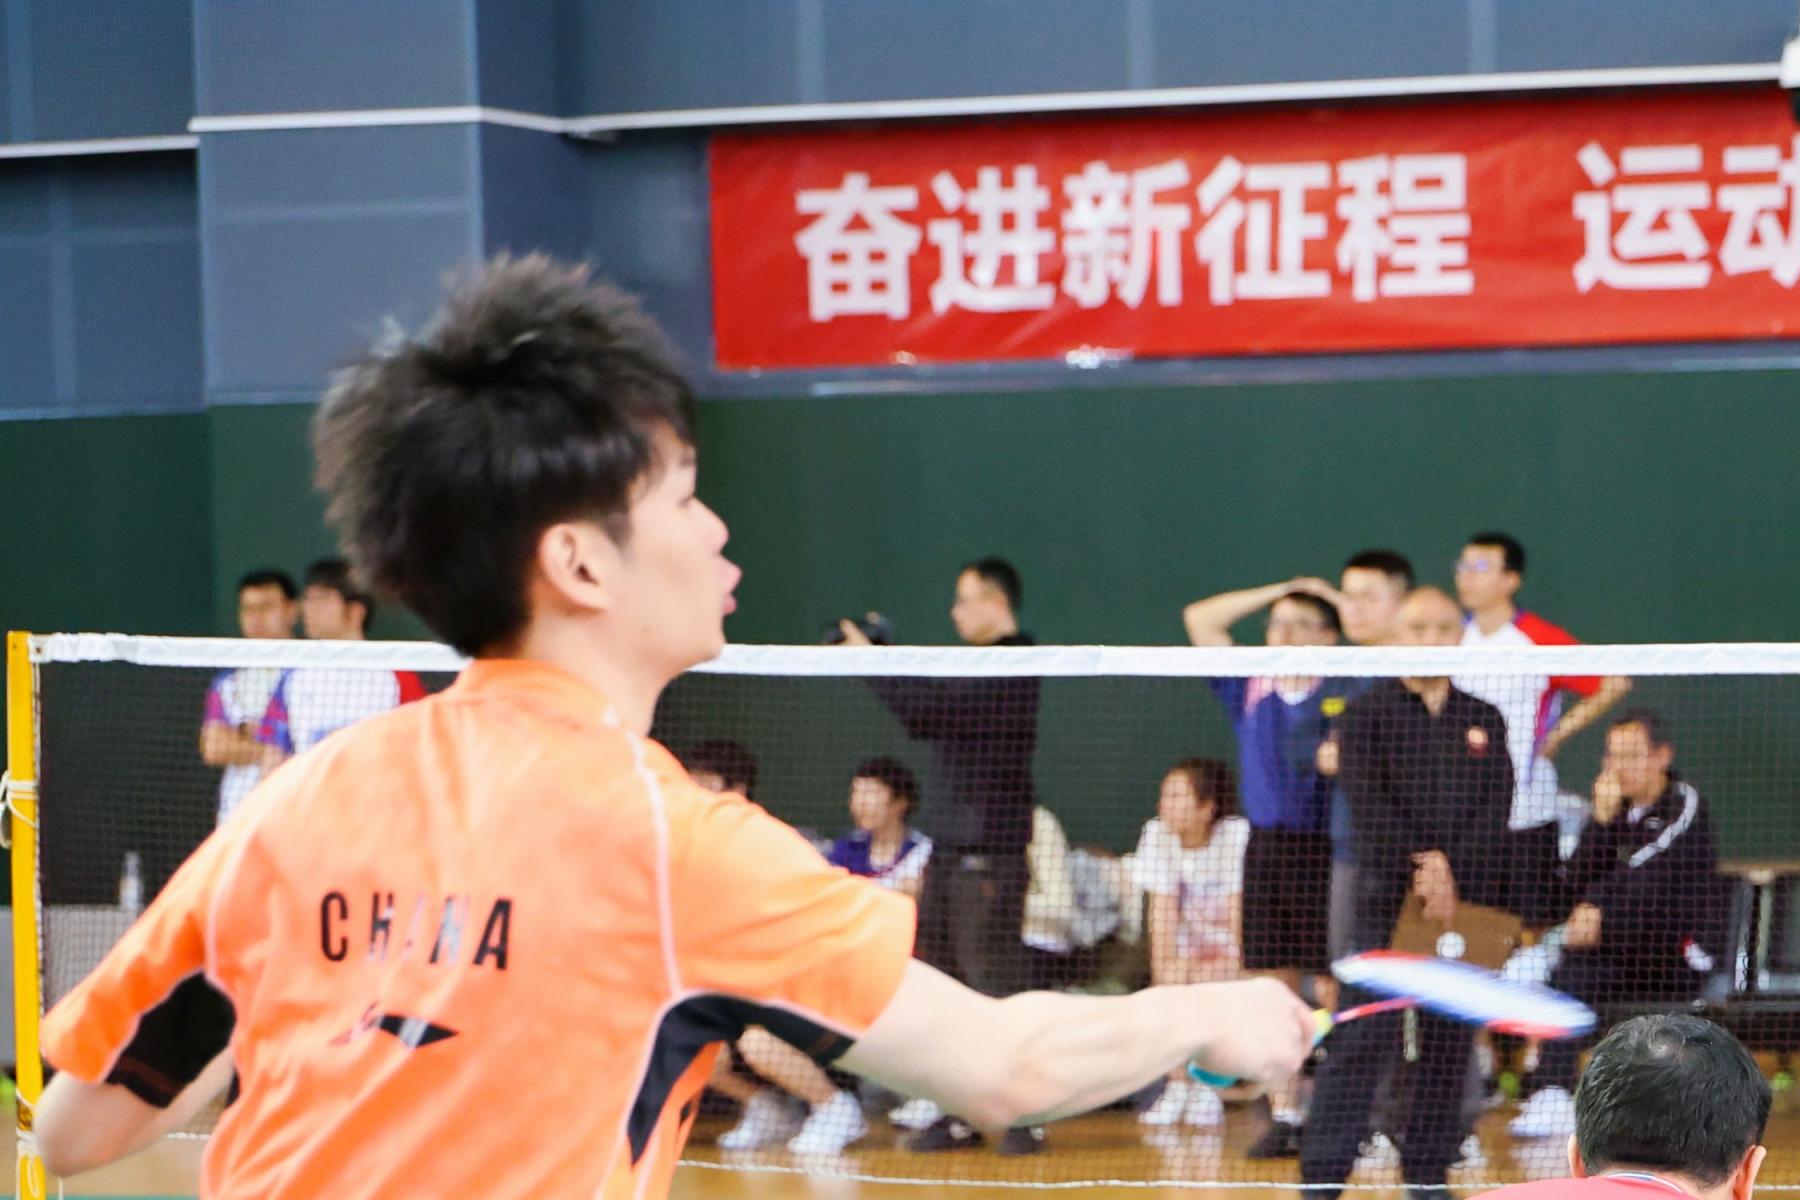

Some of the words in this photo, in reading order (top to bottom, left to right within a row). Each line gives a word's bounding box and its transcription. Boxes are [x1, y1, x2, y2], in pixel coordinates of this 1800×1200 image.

[795, 151, 1475, 322] 奋进新征程
[319, 891, 514, 969] CHINA
